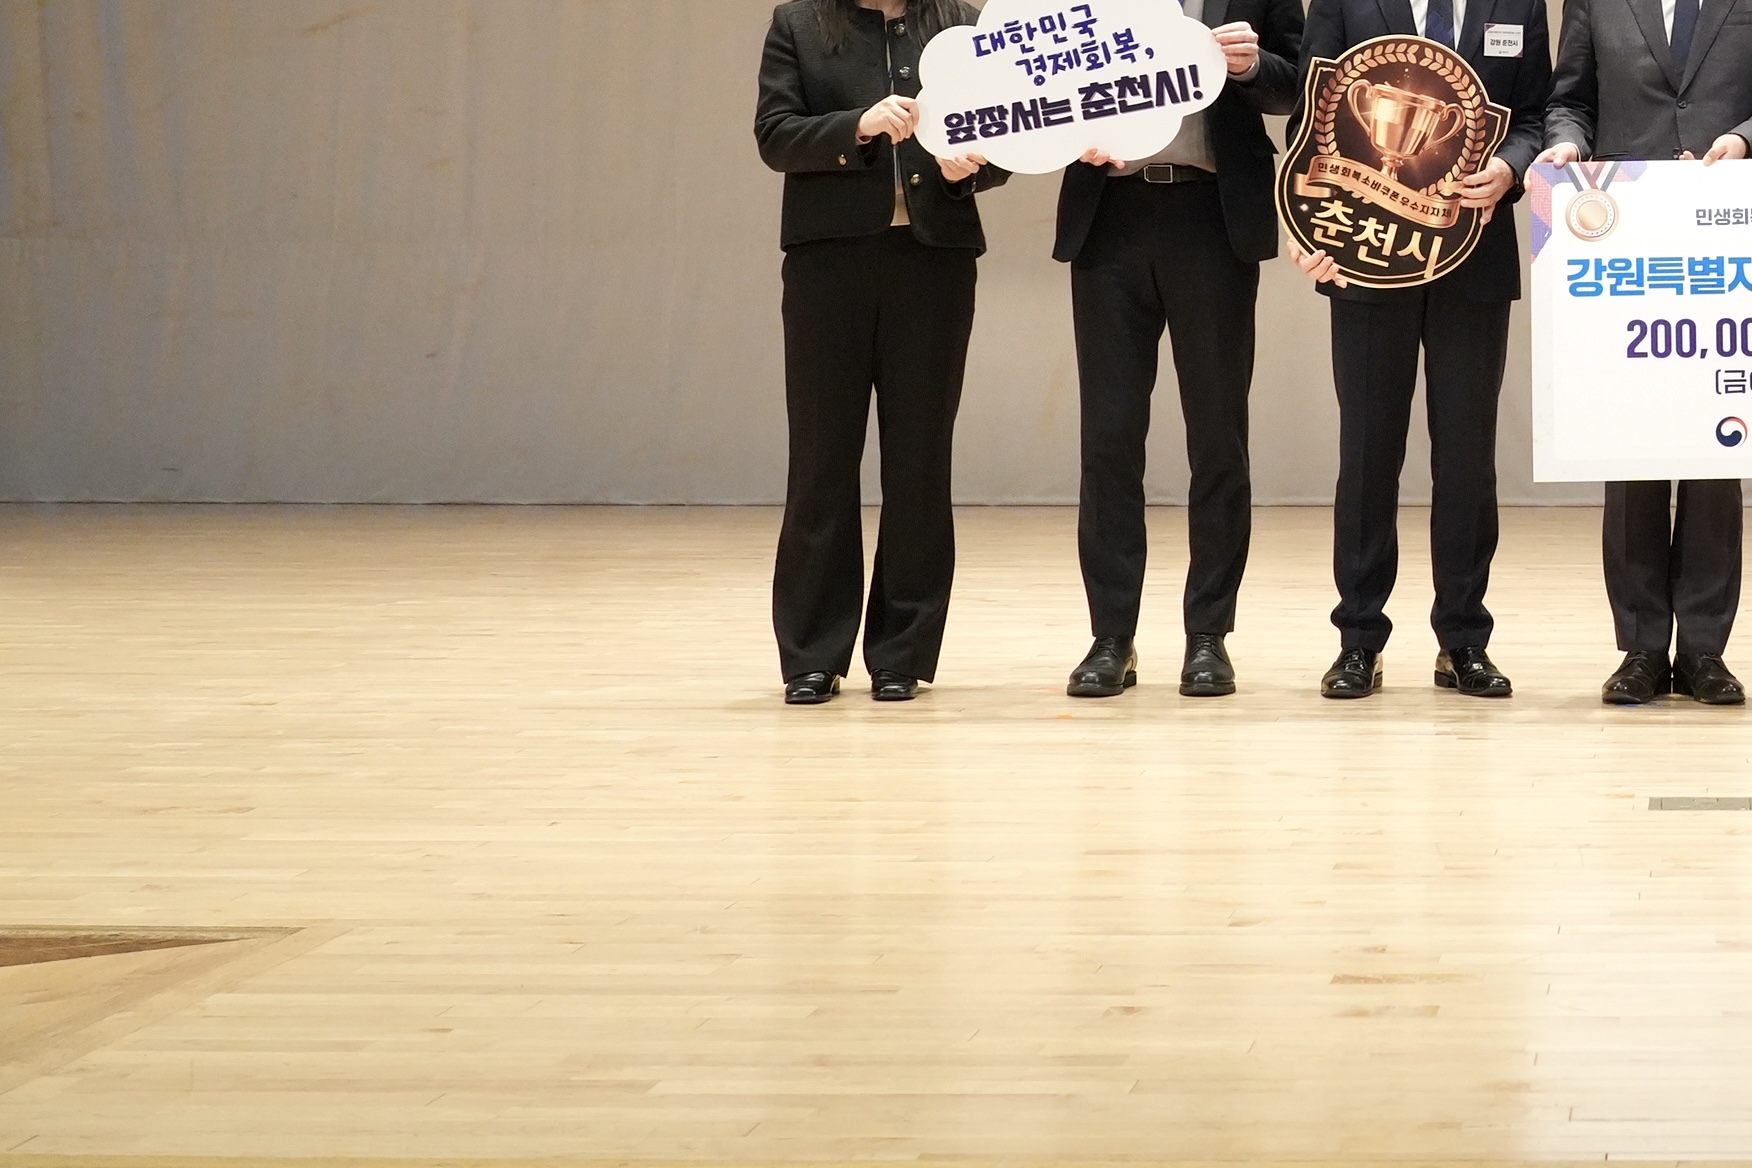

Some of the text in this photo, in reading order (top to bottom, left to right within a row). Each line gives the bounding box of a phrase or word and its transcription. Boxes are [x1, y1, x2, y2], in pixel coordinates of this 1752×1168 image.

[972, 3, 1098, 58] 대한민국
[1015, 27, 1155, 87] 경제회복,
[943, 64, 1204, 146] 앞장서는 춘천시!
[1309, 198, 1444, 279] 춘천시
